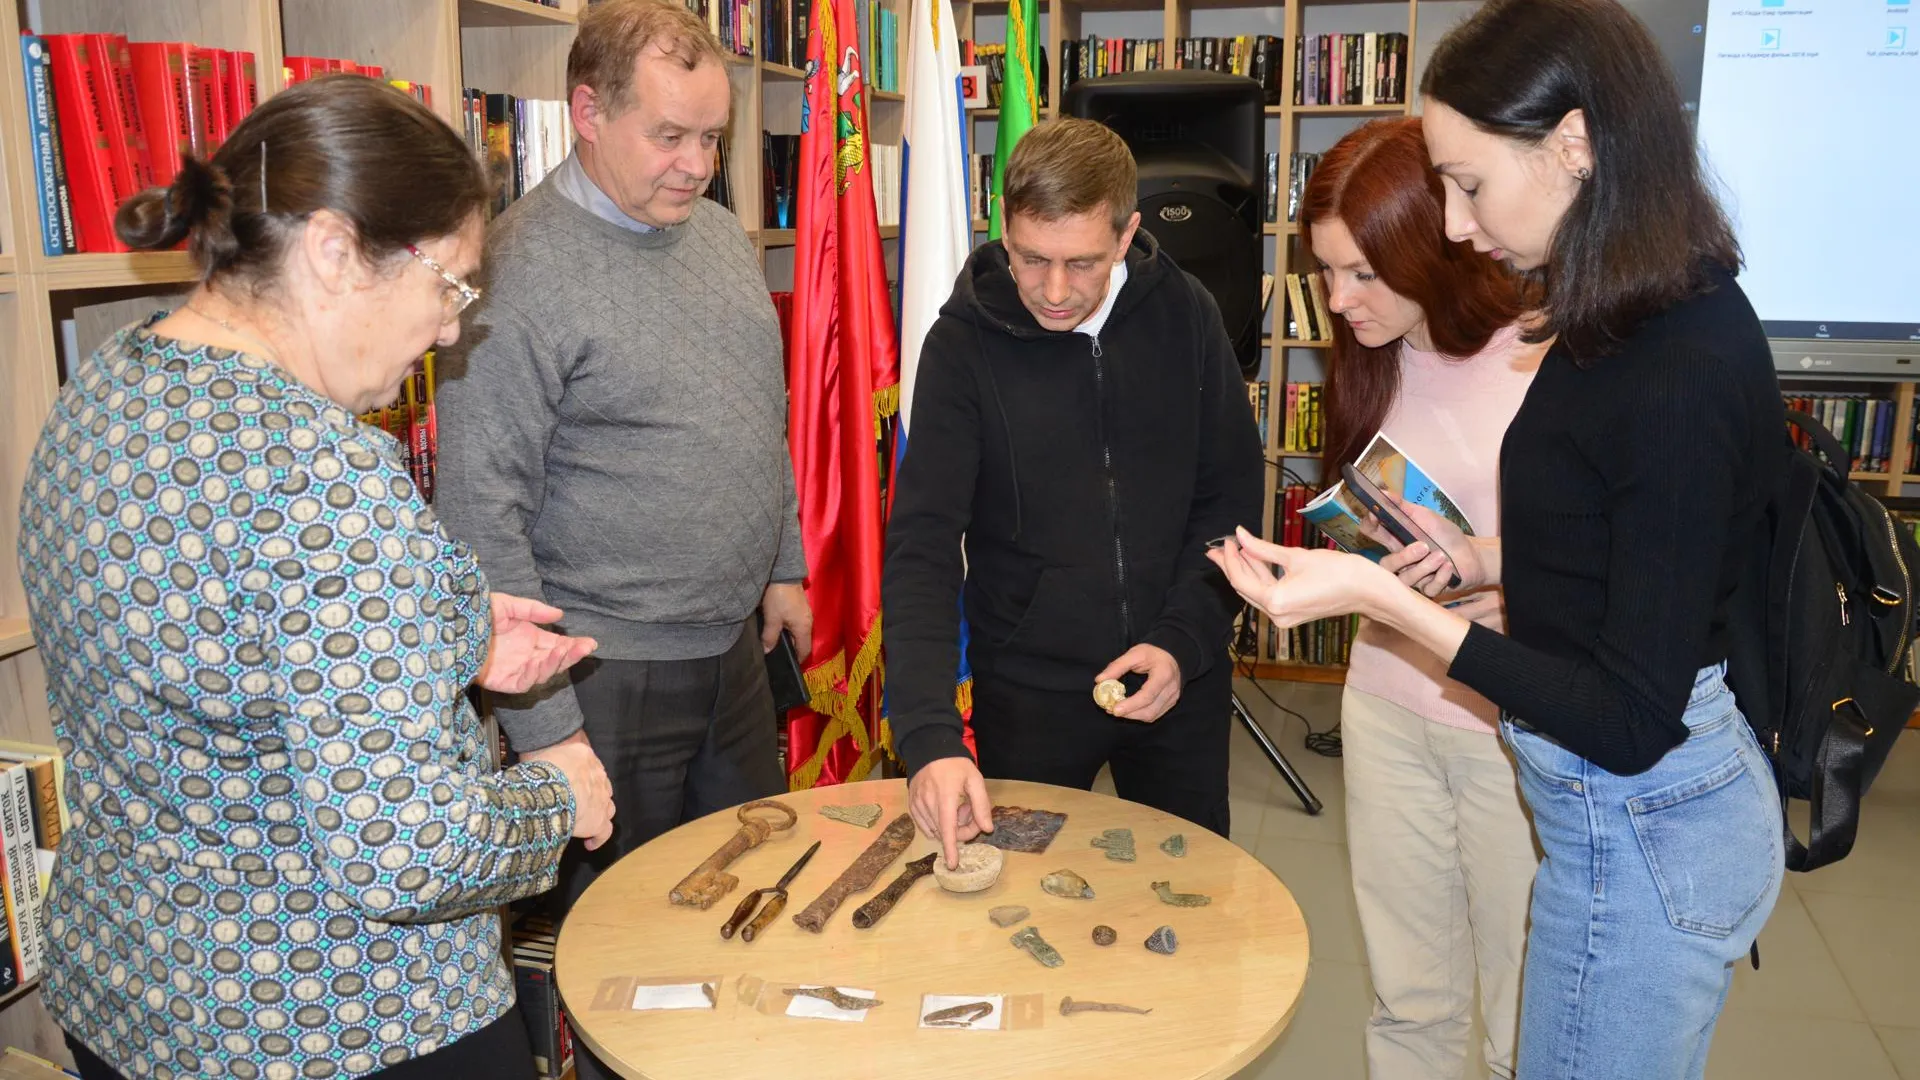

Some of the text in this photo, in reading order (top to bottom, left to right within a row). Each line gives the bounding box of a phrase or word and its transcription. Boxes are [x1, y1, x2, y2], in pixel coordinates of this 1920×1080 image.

[33, 65, 48, 128] ДЕТЕКТИВ
[39, 132, 60, 248] ОСТРОСЮЖЕТНЫЙ
[1, 790, 15, 838] СВИТОК
[16, 786, 30, 833] СВИТОК
[8, 845, 24, 906] ЗВЕЗДНЫЙ
[22, 840, 39, 901] ЗВЕЗДНЫЙ
[18, 909, 33, 958] М.РОУН
